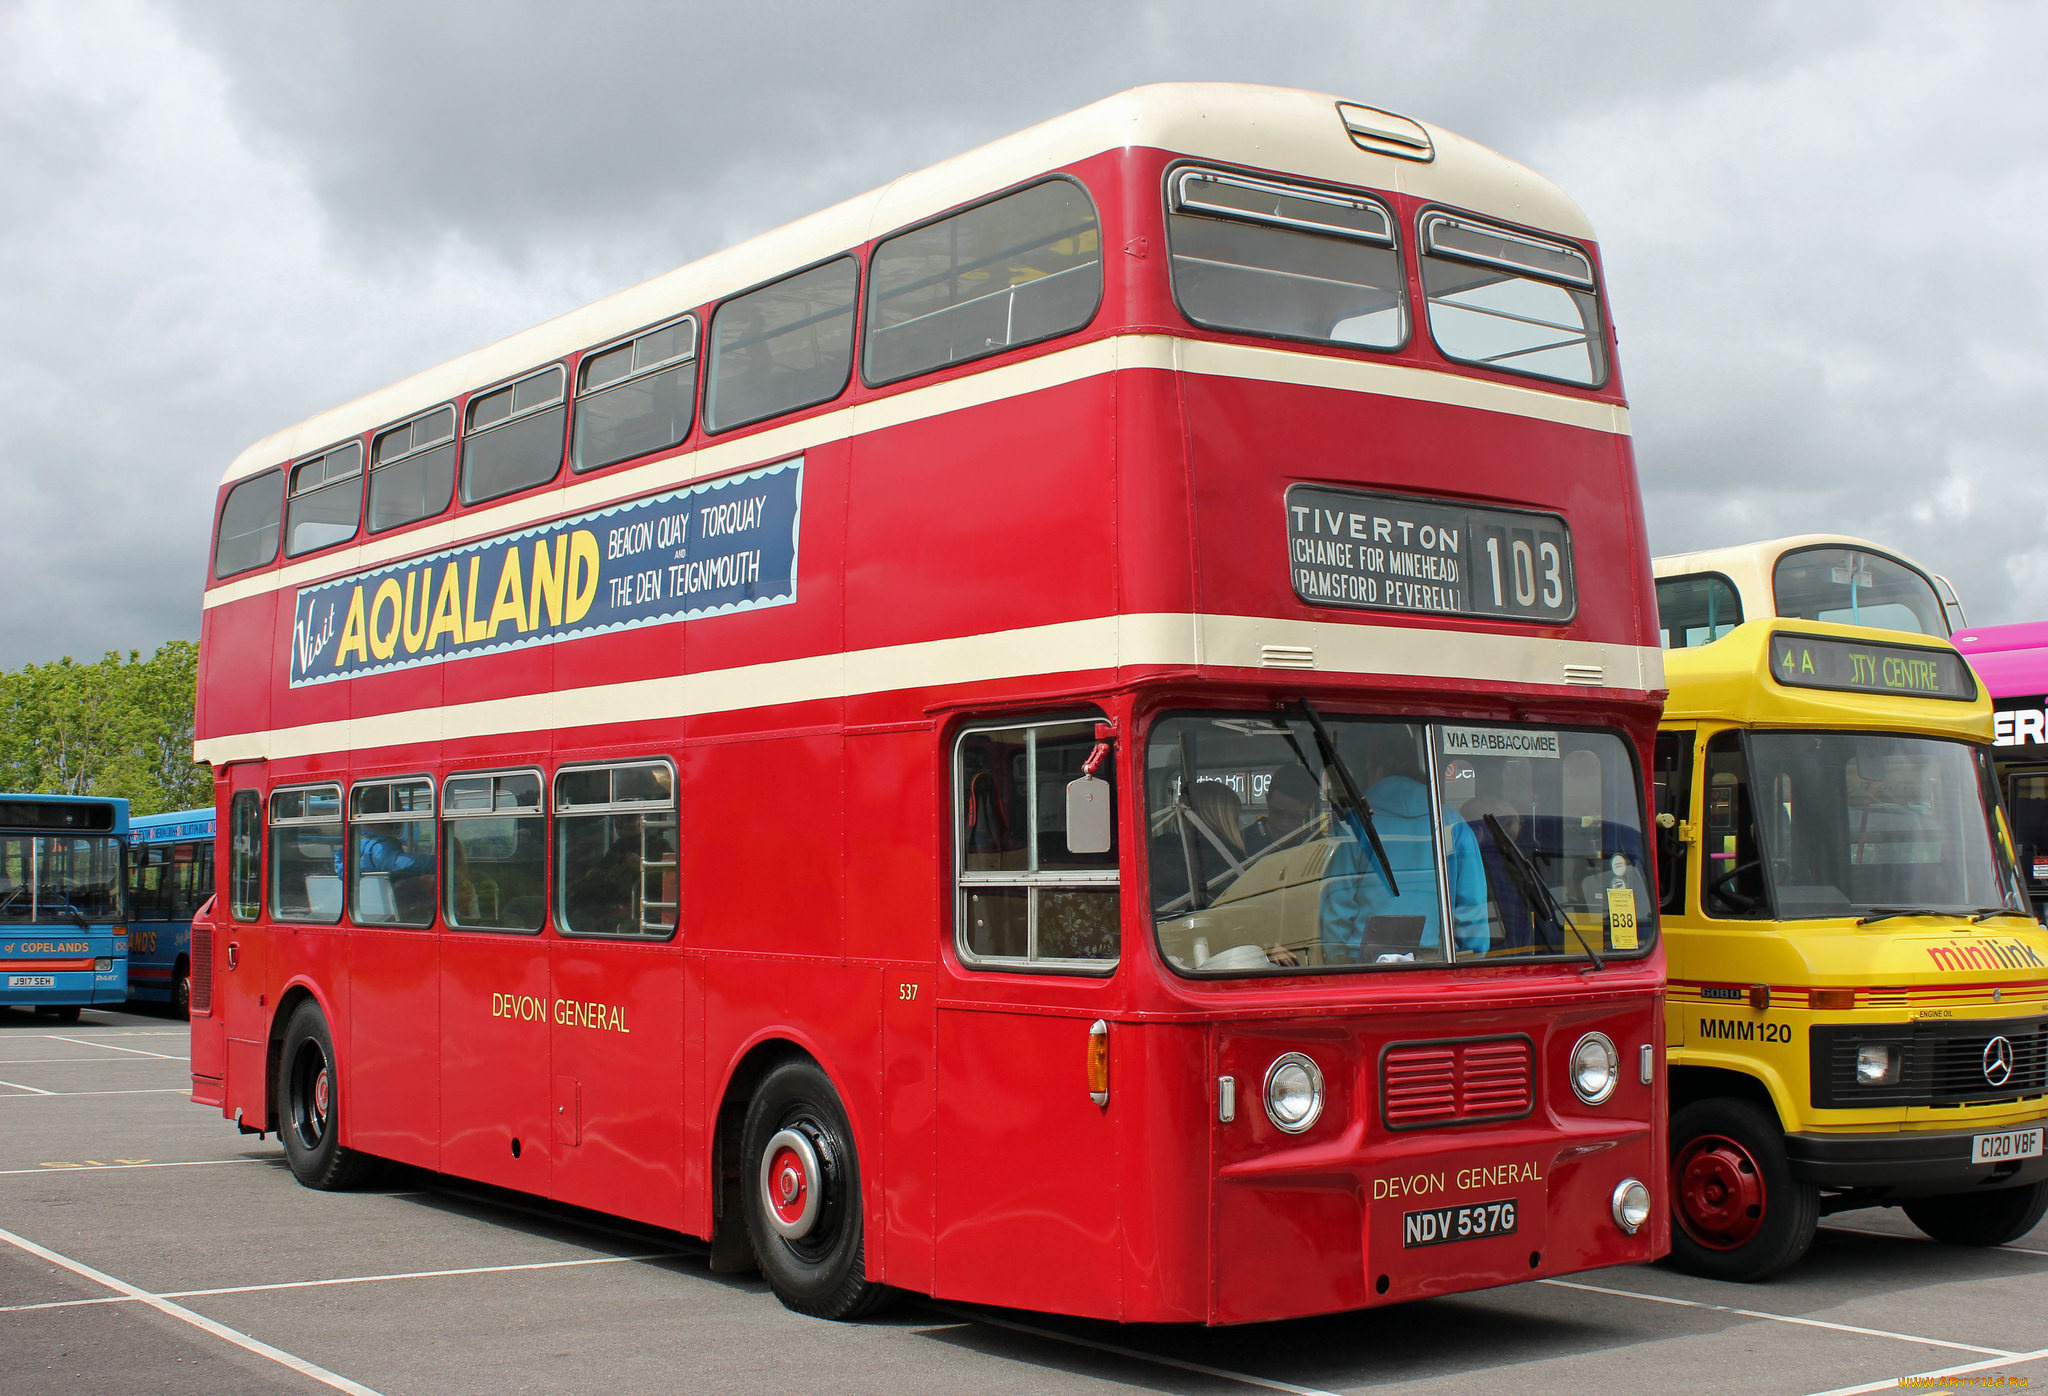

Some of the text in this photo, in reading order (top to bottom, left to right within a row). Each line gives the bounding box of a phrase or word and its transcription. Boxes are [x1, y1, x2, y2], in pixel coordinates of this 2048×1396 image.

[608, 495, 766, 560] BEACON QUAY TORQUAY
[1291, 506, 1458, 553] TIVERTON
[674, 549, 686, 559] AND
[1292, 538, 1459, 583] (CHANGE FOR MINEHEAD)
[609, 550, 760, 608] THE DEN TEIGNMOUTH
[1295, 569, 1377, 602] (PAMSFORD
[1487, 537, 1563, 608] 103
[297, 529, 600, 674] Visit AQUALAND
[1883, 657, 1939, 690] CENTRE
[1447, 733, 1556, 751] VIA BABBACOMBE
[1992, 709, 2048, 746] ER
[1612, 913, 1633, 928] B38
[4, 942, 90, 953] of COPELANDS
[1927, 938, 2045, 971] minilink
[14, 977, 51, 986] J917 SEH
[899, 984, 918, 1001] 537
[492, 992, 630, 1033] DEVON GENERAL
[1920, 1010, 1942, 1018] ENGINE
[1982, 1132, 2036, 1157] C120 VBF
[1373, 1161, 1543, 1200] DEVON GENERAL
[1406, 1203, 1515, 1244] NDV 537G
